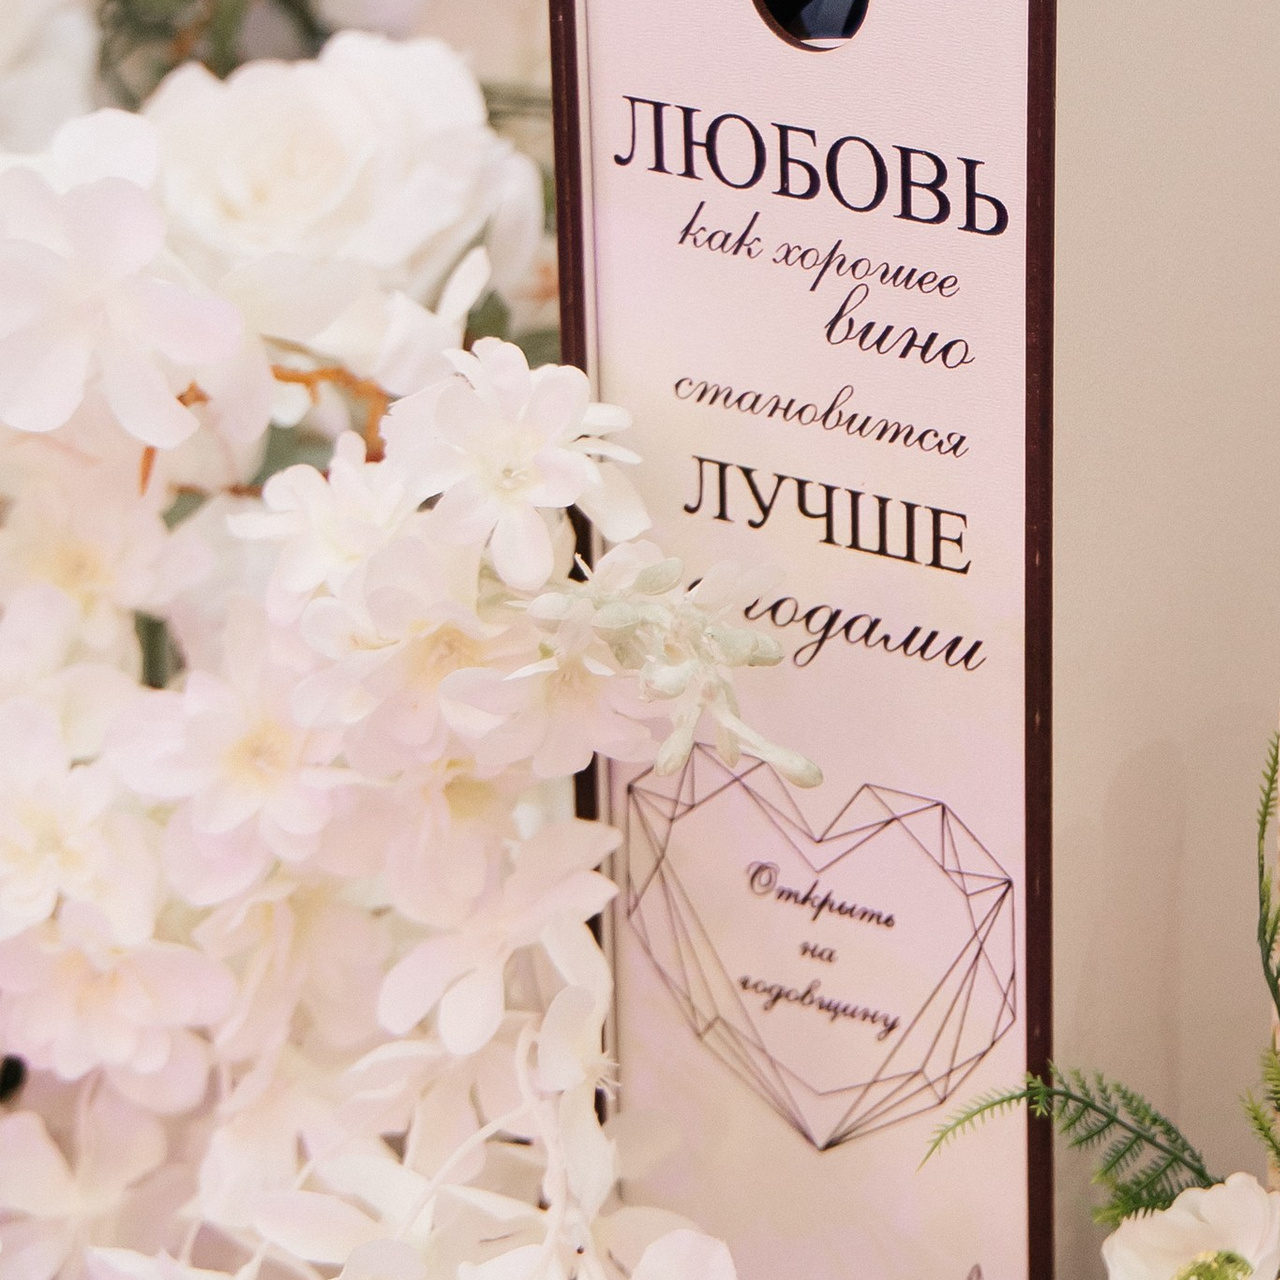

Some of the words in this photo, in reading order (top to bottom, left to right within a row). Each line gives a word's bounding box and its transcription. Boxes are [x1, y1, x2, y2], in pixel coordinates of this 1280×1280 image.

[612, 94, 1010, 237] ЛЮБОВЬ
[677, 200, 763, 260] как
[772, 238, 961, 298] хорошее
[824, 282, 976, 370] вино
[673, 376, 971, 458] становится
[683, 455, 973, 575] ЛУЧШЕ
[747, 861, 896, 929] Открыть
[801, 940, 837, 964] на
[738, 975, 901, 1042] годовщину
